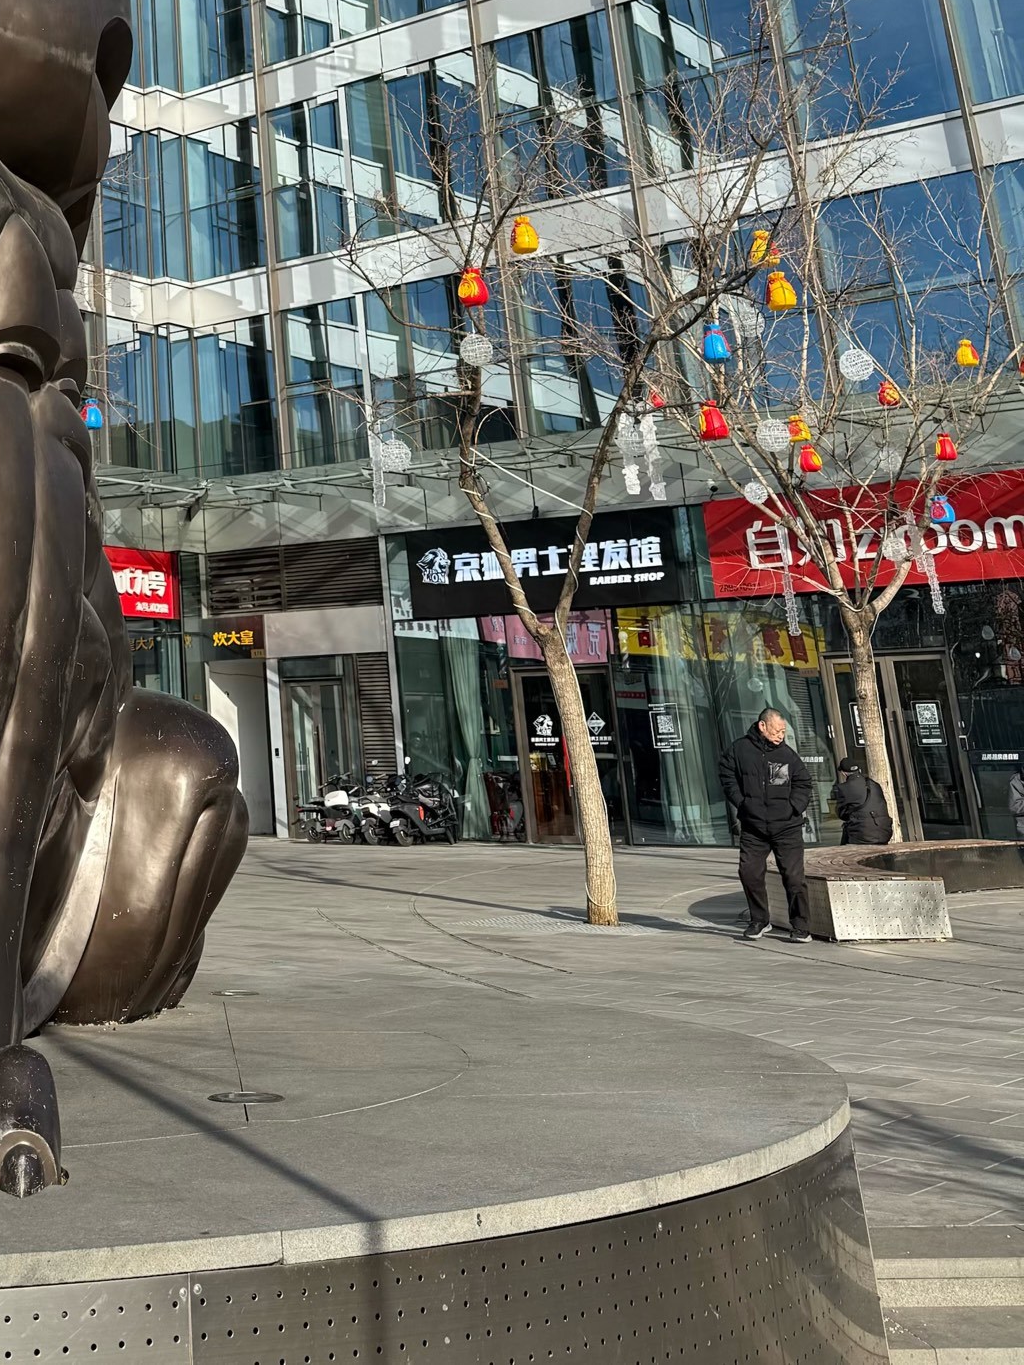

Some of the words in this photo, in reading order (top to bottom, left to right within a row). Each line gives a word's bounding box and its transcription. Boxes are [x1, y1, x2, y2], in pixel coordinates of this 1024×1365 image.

[856, 515, 1024, 559] zroom
[589, 574, 632, 586] BARBER
[633, 572, 665, 583] SHOP
[213, 629, 254, 647] 炊大皇
